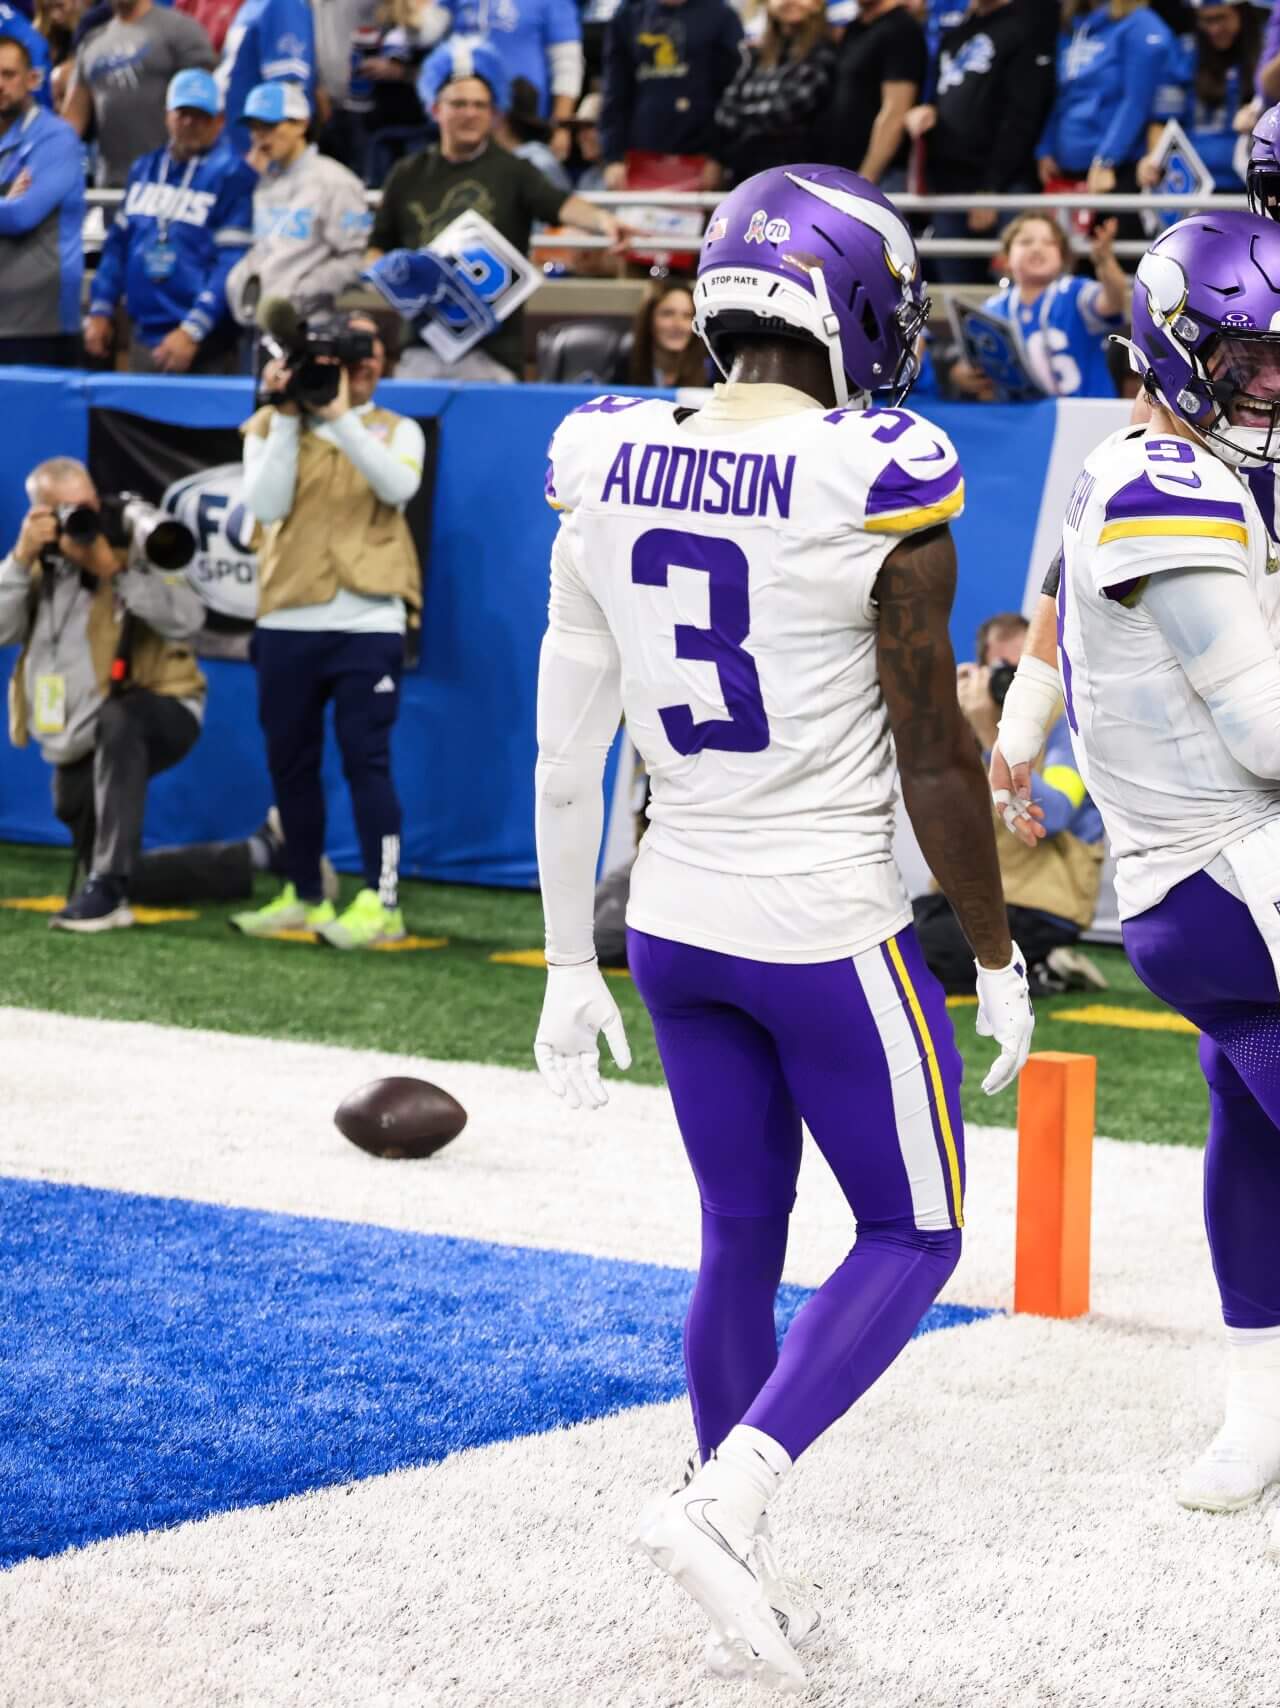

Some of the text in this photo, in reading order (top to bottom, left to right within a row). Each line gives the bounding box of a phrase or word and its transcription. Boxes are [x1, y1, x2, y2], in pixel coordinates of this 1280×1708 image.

[711, 275, 759, 286] STOP HATE
[600, 441, 796, 519] ADDISON
[197, 493, 258, 556] FO
[632, 527, 770, 756] 3
